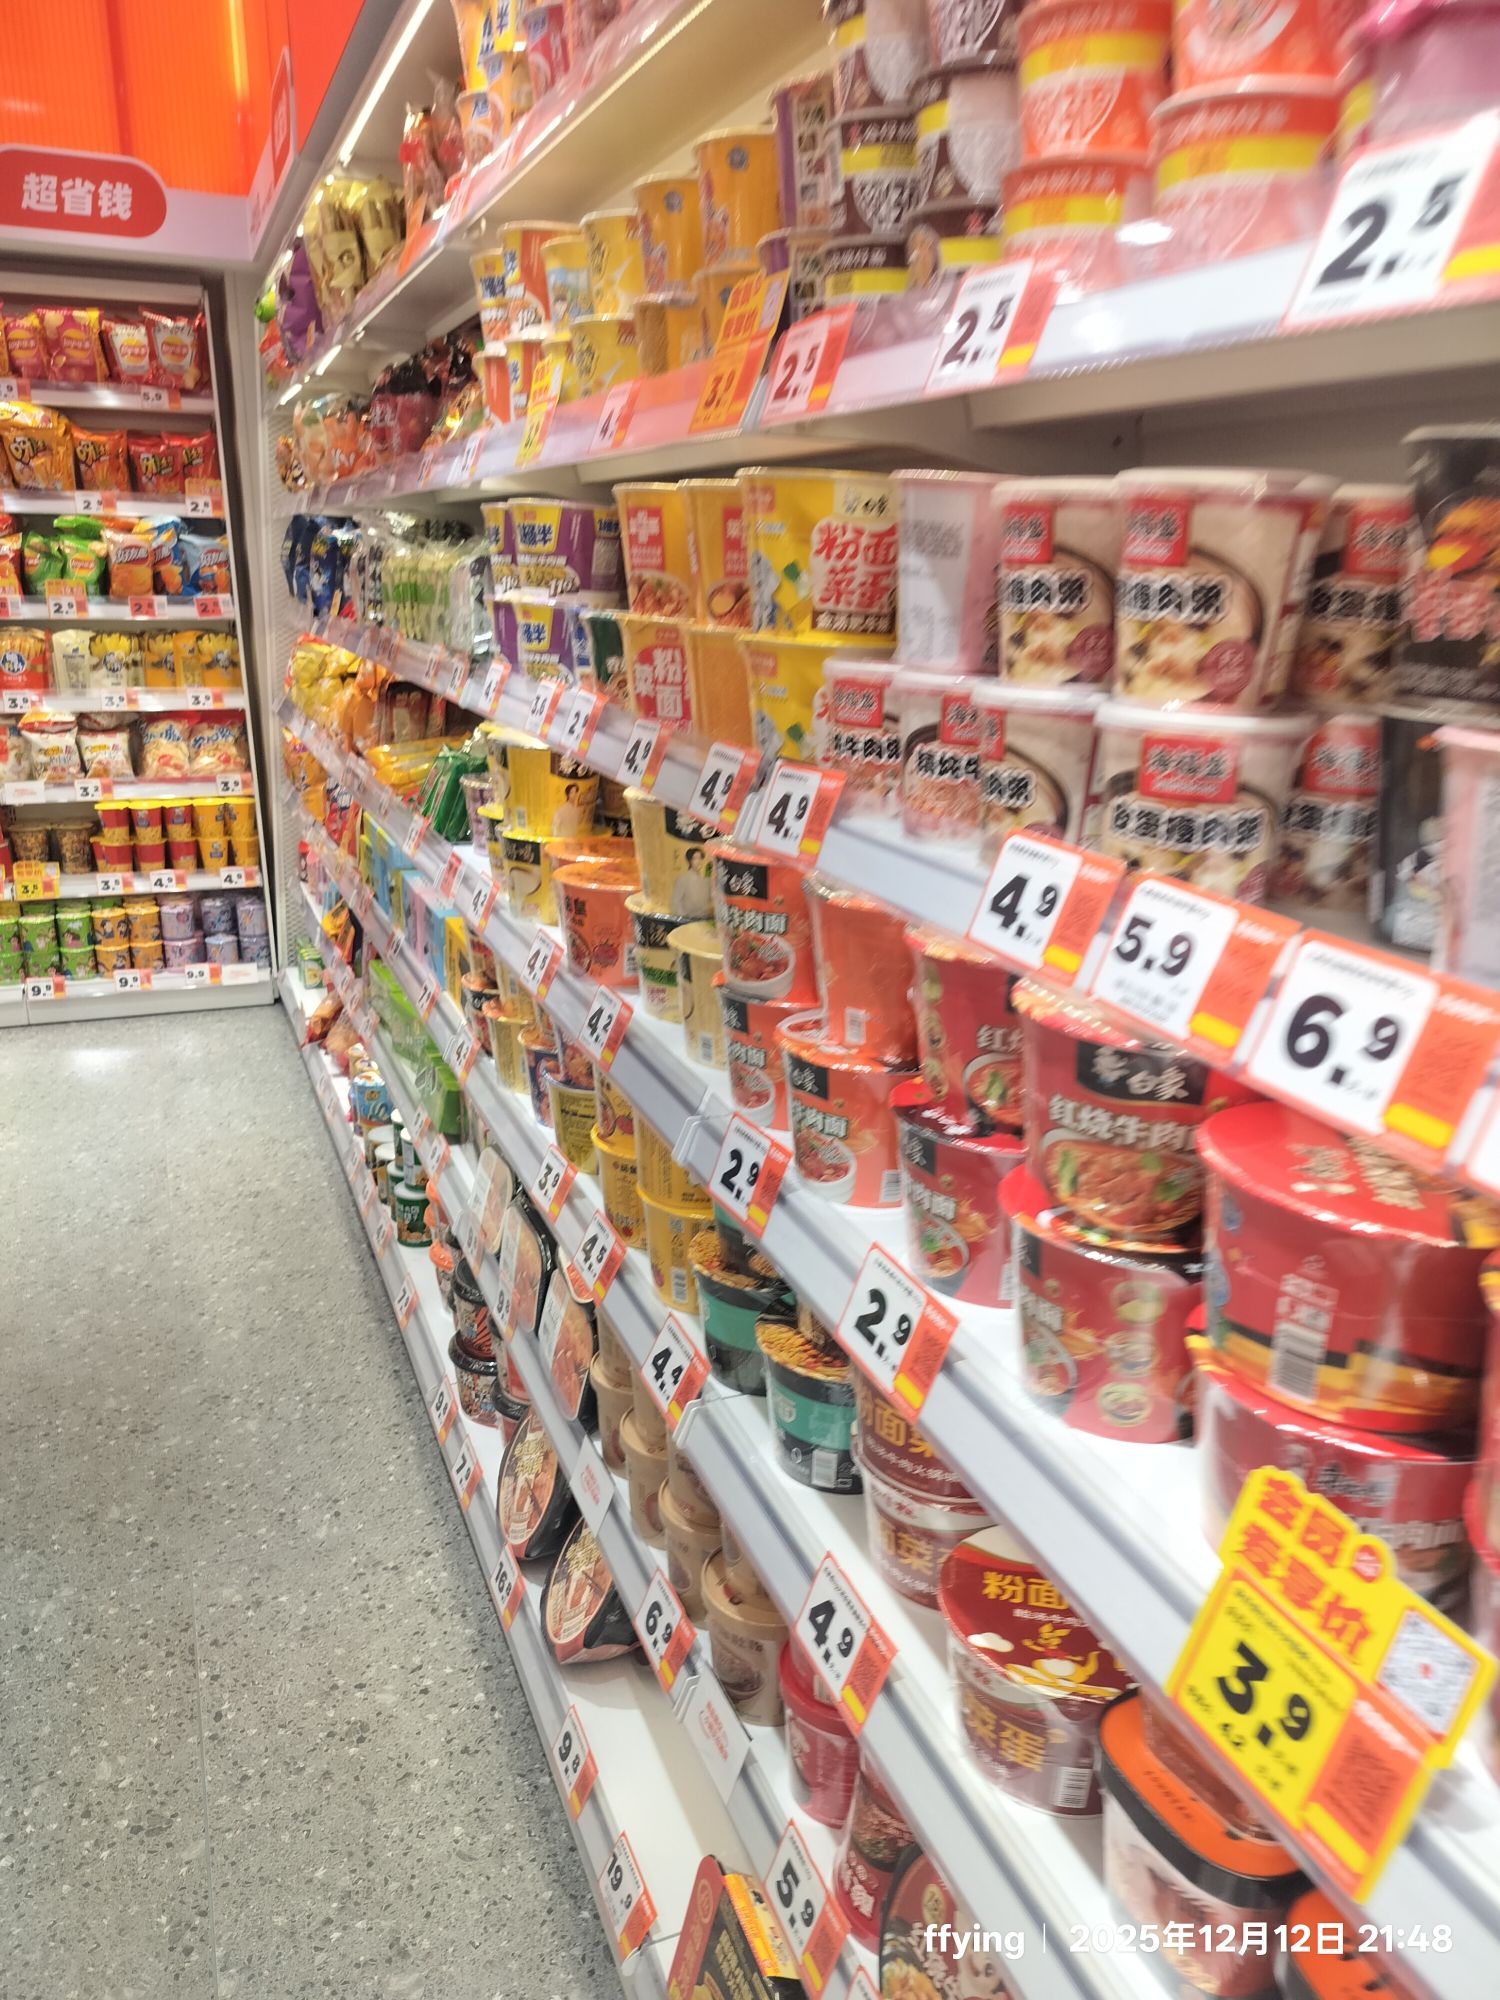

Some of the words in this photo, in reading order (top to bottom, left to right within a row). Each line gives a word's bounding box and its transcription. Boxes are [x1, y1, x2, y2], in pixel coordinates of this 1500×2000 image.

[21, 172, 132, 221] 超省钱
[143, 390, 162, 402] 5.9
[8, 697, 28, 709] 3.9
[80, 785, 99, 798] 3.2
[768, 792, 810, 839] 4.9
[989, 873, 1060, 939] 4.9
[1112, 914, 1193, 978] 5.9
[31, 985, 51, 998] 9.9
[587, 1004, 613, 1043] 4.2
[1287, 994, 1400, 1086] 6.9
[720, 1148, 761, 1201] 2.9
[854, 1287, 912, 1358] 2.9
[646, 1600, 672, 1649] 6.9
[808, 1599, 854, 1664] 4.9
[1216, 1640, 1313, 1748] 3.9
[607, 1853, 634, 1911] 19.9
[776, 1858, 815, 1929] 5.9
